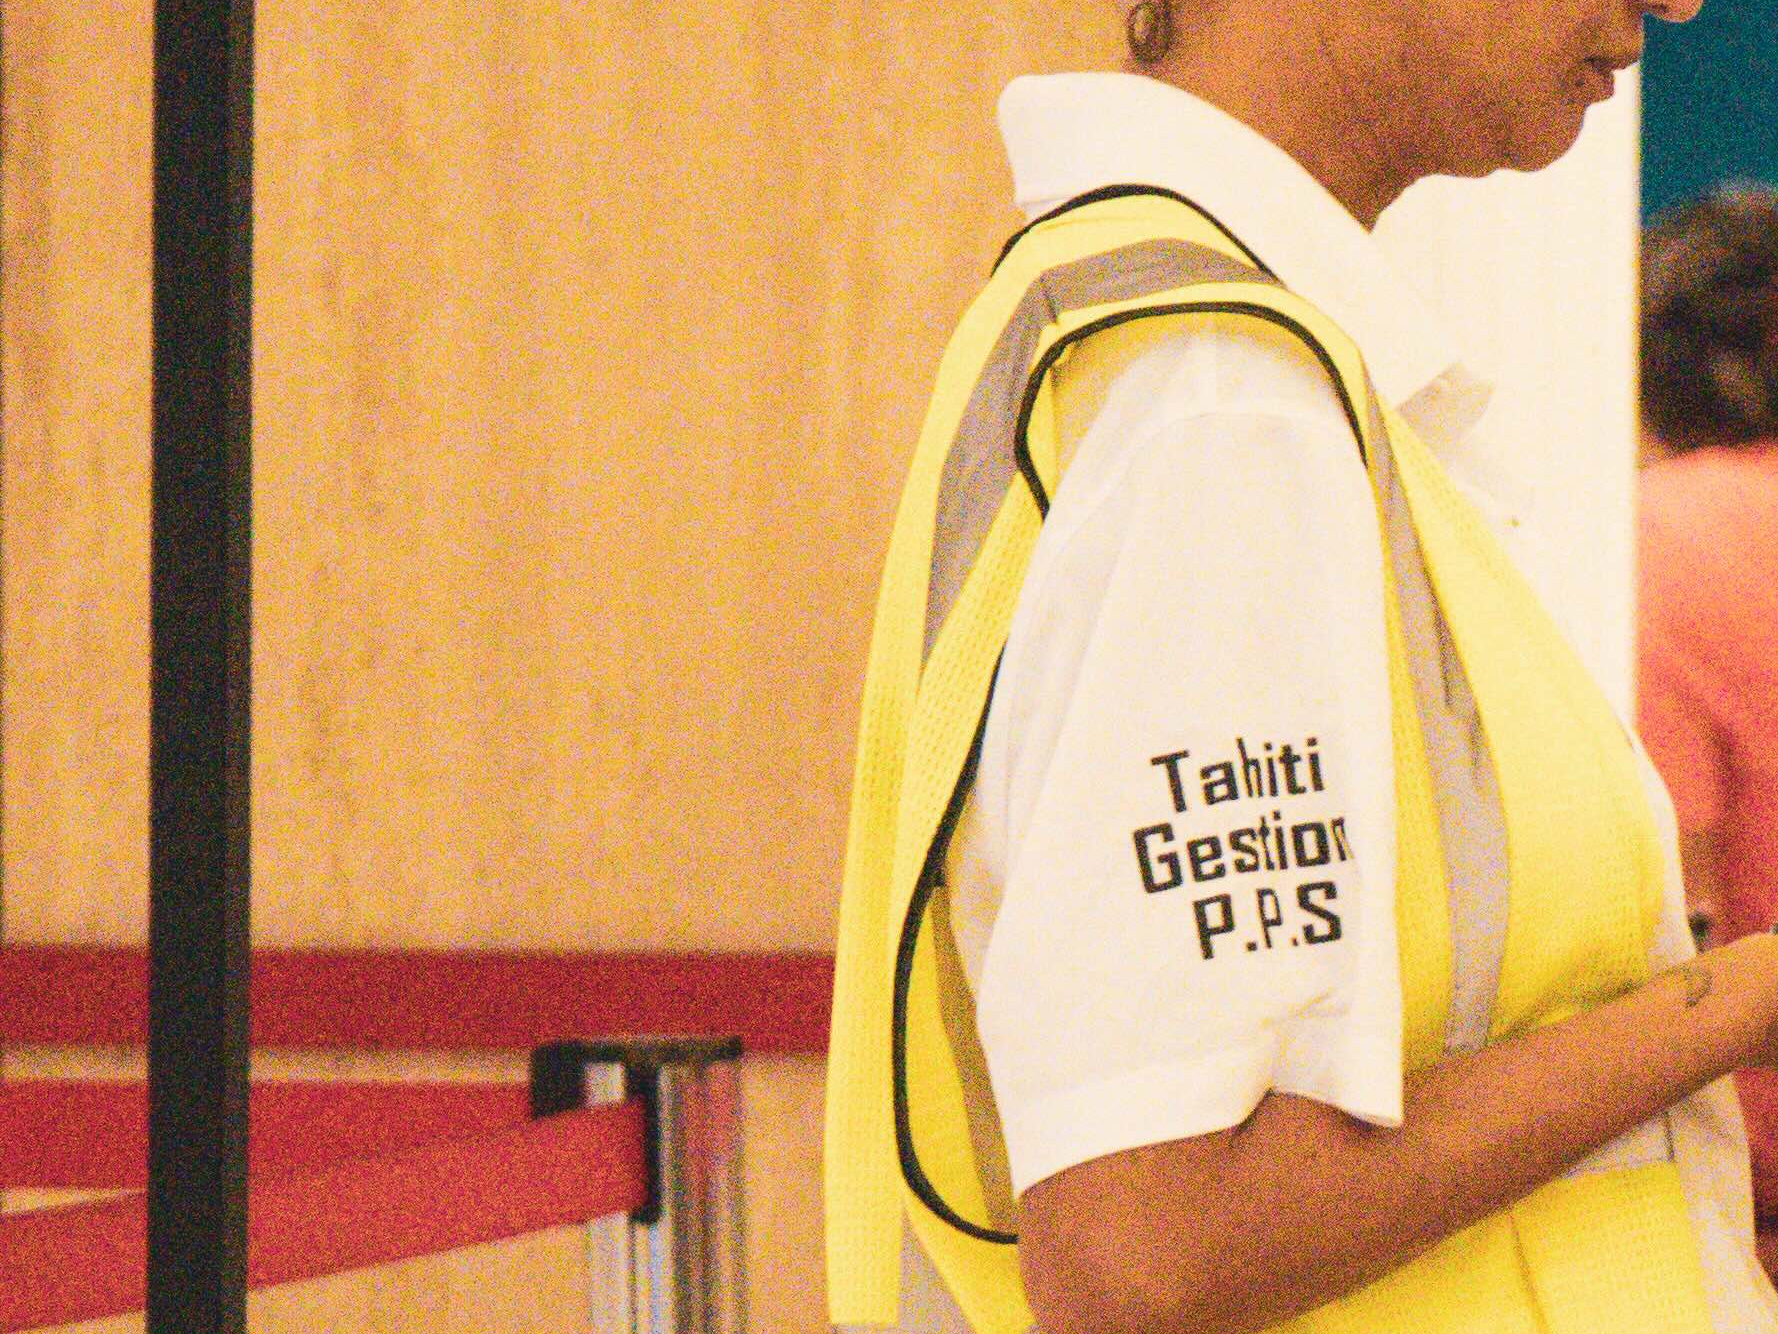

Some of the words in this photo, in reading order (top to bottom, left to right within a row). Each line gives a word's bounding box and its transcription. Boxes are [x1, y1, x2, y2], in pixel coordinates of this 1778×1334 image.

[1149, 736, 1326, 814] Tahiti
[1132, 809, 1354, 895] Gestion
[1191, 880, 1343, 961] P.P.S
